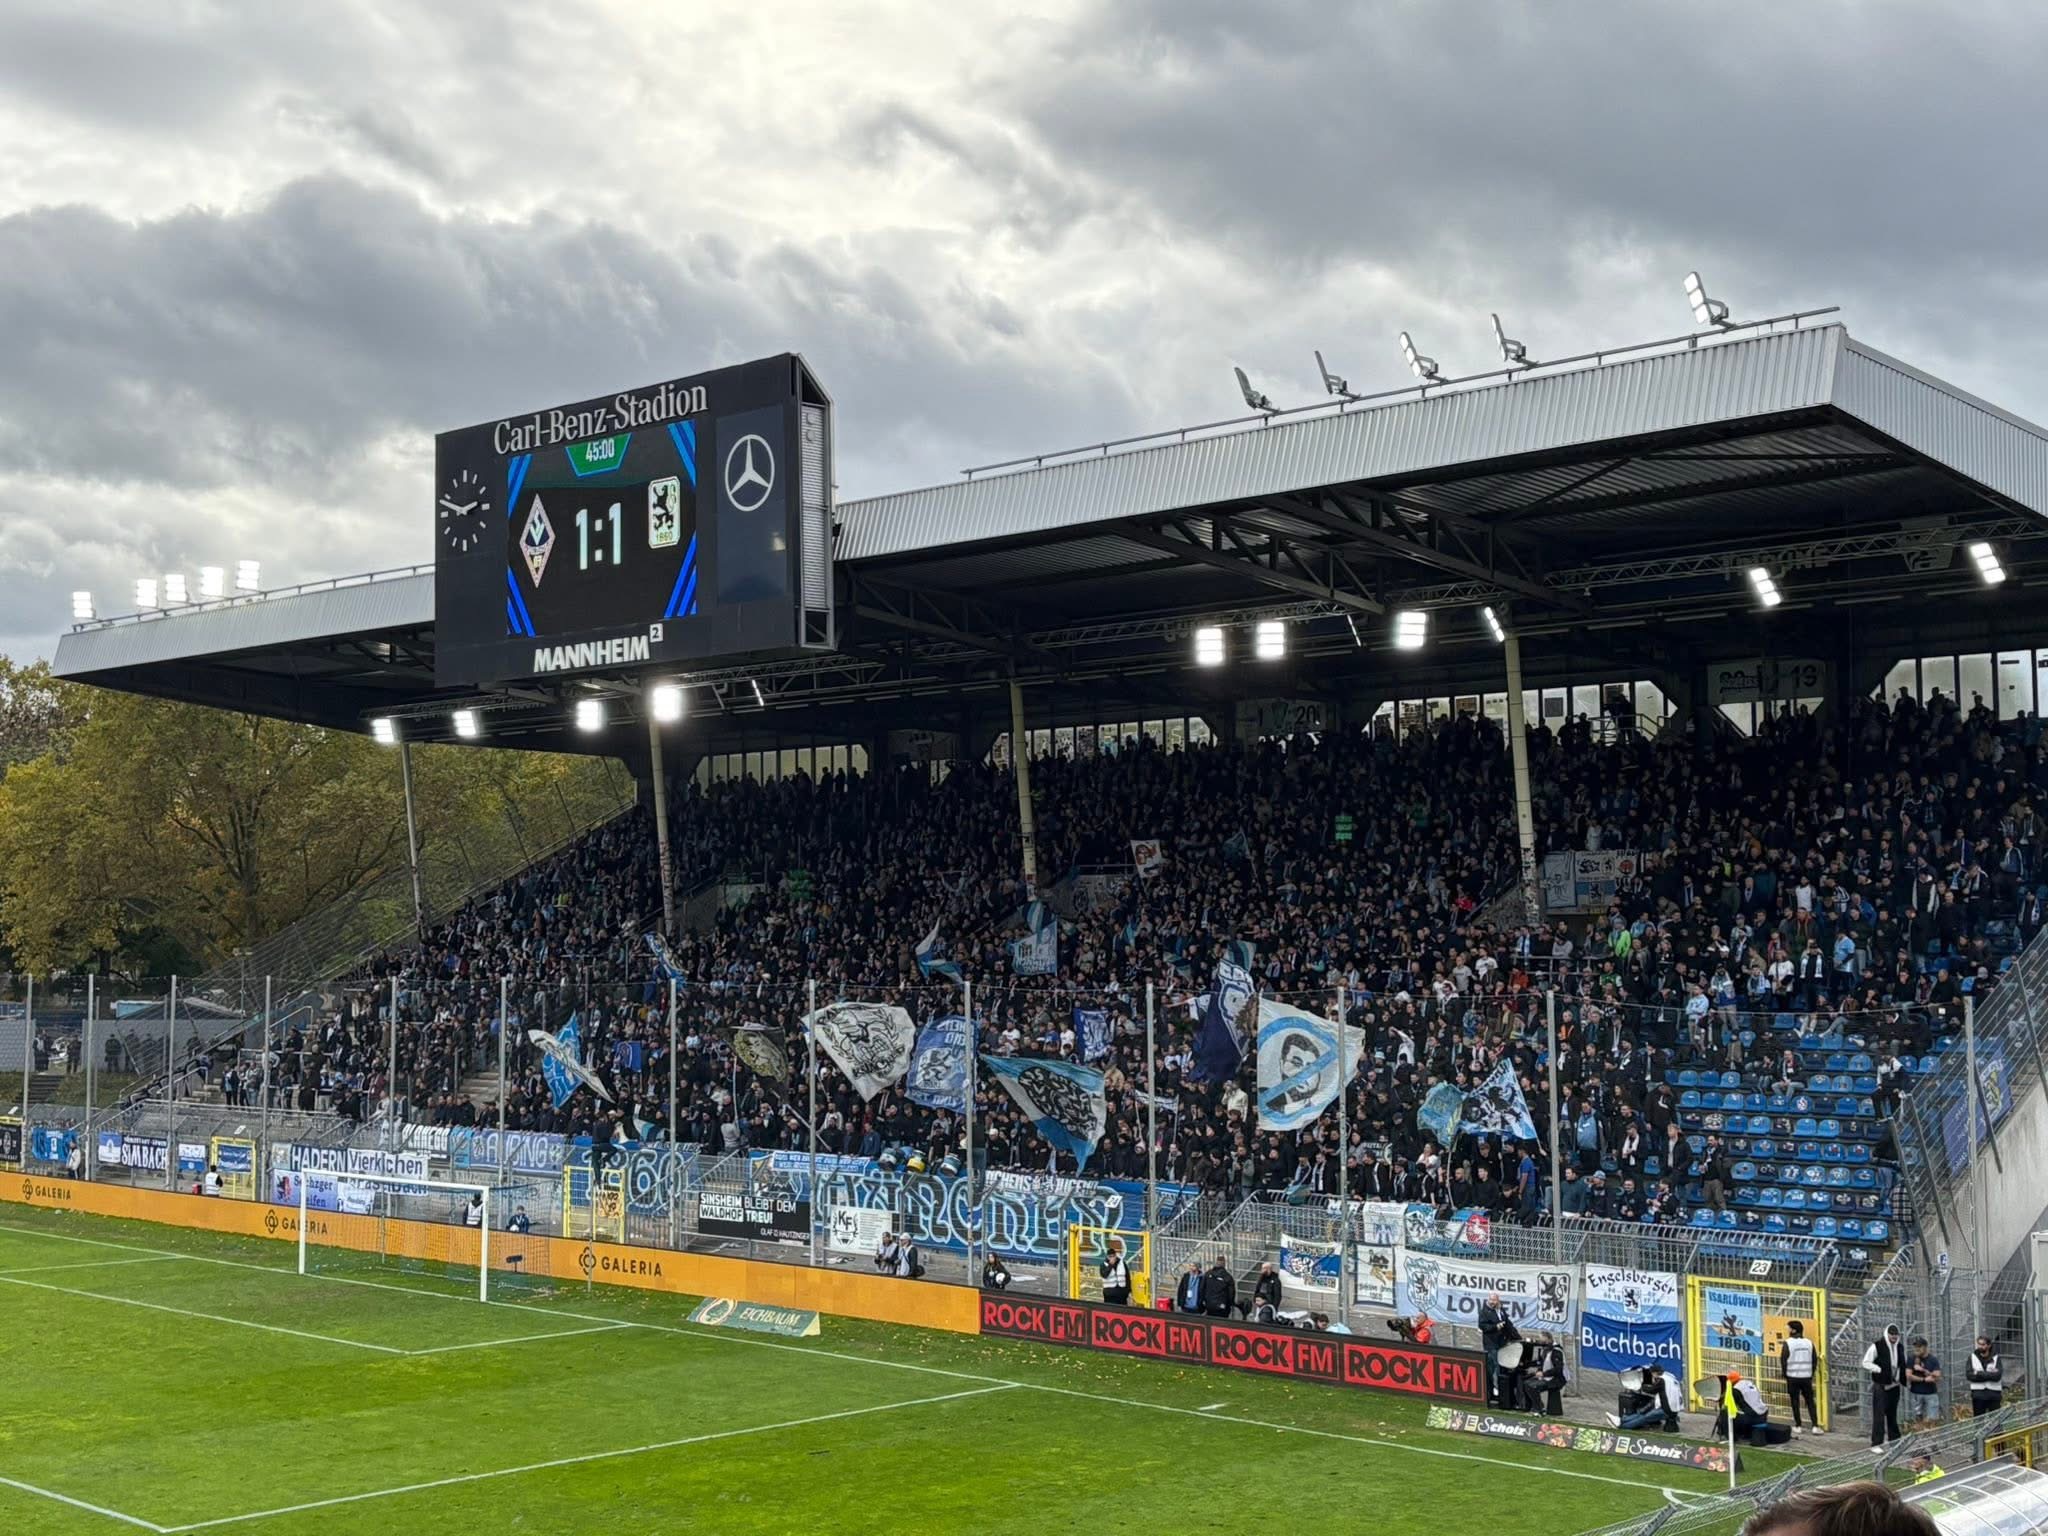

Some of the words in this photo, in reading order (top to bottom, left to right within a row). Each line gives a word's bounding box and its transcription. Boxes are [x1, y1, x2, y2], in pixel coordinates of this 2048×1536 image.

[494, 384, 708, 454] Carl-Benz-Stadion
[585, 438, 615, 462] 45:00
[575, 502, 621, 570] 1:1
[533, 635, 650, 672] MANNHEIM
[291, 1146, 347, 1173] HADERN
[35, 1185, 72, 1201] GALERIA
[701, 1193, 742, 1208] SINSHEIM
[777, 1200, 796, 1214] DEM
[701, 1206, 744, 1221] WALDHOF
[282, 1217, 328, 1236] GAERIA
[601, 1256, 662, 1277] GALERIA
[1752, 1261, 1768, 1274] 23
[1446, 1273, 1527, 1294] KASINGER
[740, 1306, 801, 1327] EICHBAUM
[984, 1301, 1046, 1334] ROCK
[1053, 1311, 1084, 1339] FM
[1095, 1317, 1163, 1350] ROCK
[1170, 1327, 1202, 1355] FM
[1215, 1333, 1291, 1368] ROCK
[1298, 1344, 1334, 1375] FM
[1349, 1350, 1431, 1388] ROCK
[1439, 1361, 1478, 1394] FM
[1582, 1324, 1681, 1360] Buchbach
[1717, 1335, 1751, 1352] 1860
[1477, 1416, 1526, 1437] Scholz
[1629, 1437, 1682, 1460] Scholz
